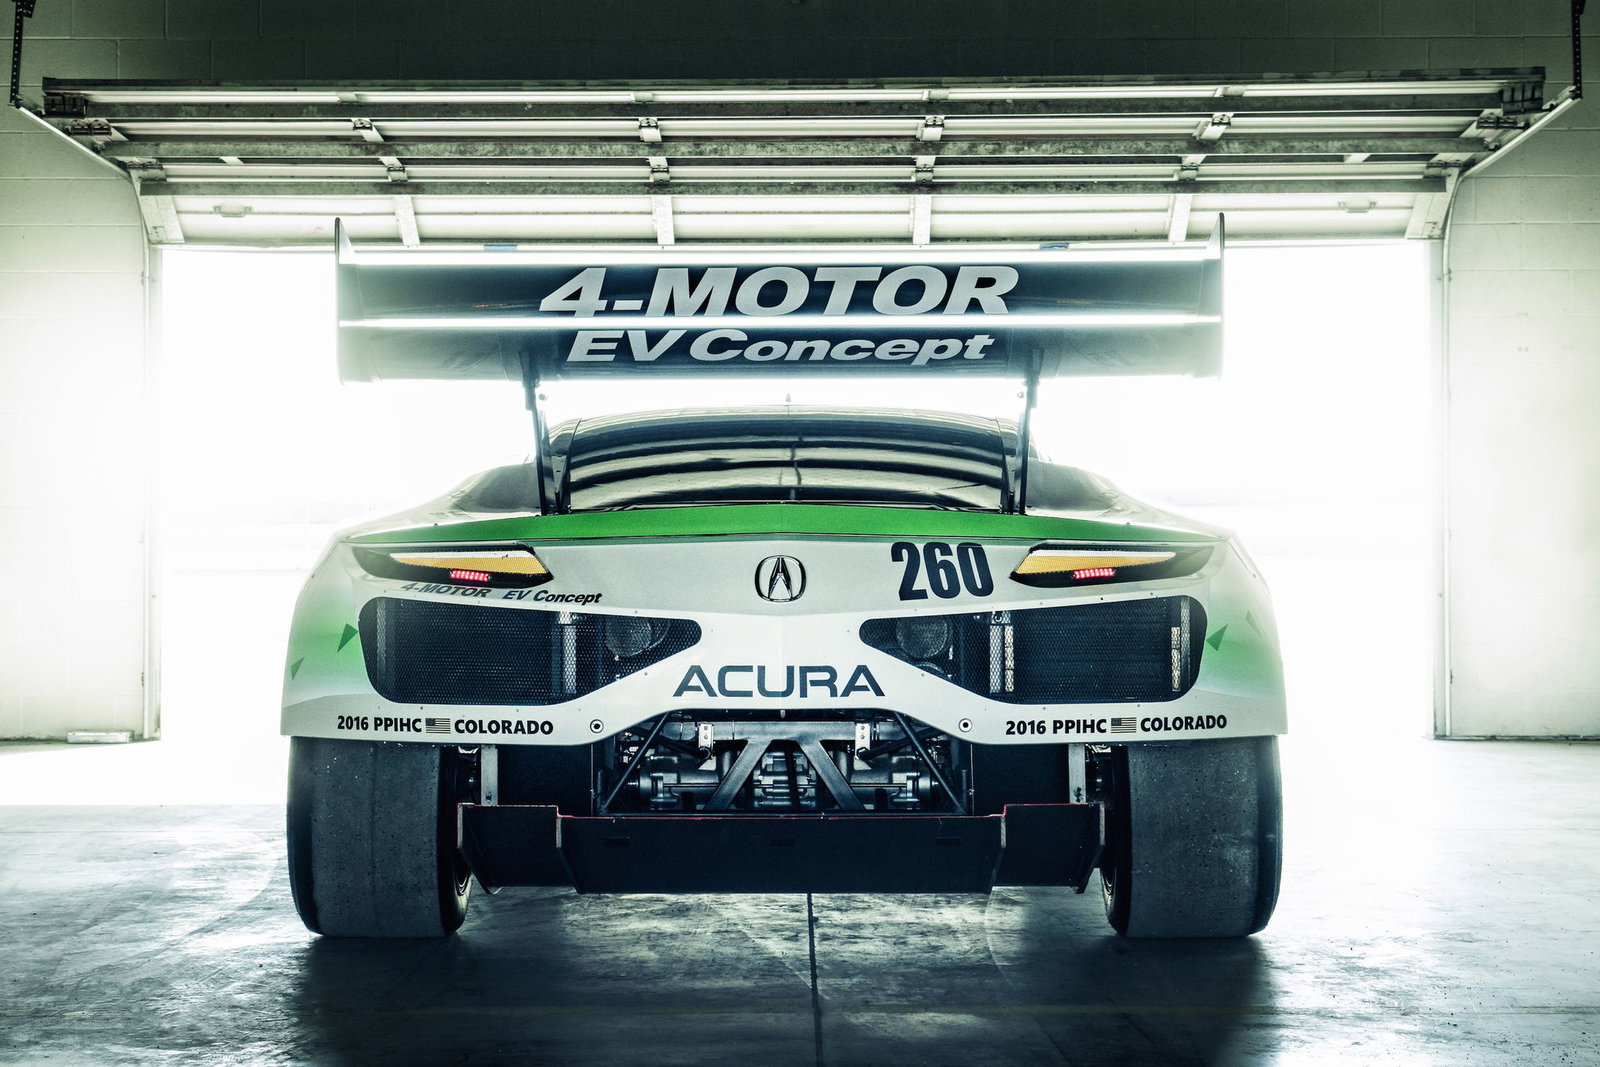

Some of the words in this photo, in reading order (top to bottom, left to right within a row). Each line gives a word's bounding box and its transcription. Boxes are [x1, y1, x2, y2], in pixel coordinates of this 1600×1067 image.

[538, 265, 1019, 317] 4-MOTOR
[566, 329, 687, 362] EV
[689, 329, 995, 366] Concept
[891, 541, 994, 601] 260
[400, 582, 492, 598] 4-MOTOR
[501, 590, 532, 601] EV
[533, 589, 603, 606] Concept
[672, 664, 886, 698] ACURA
[337, 715, 369, 731] 2016
[373, 716, 422, 733] PPIHC
[454, 719, 554, 735] COLORADO
[1005, 719, 1046, 736] 2016
[1052, 718, 1107, 734] PPIHC
[1140, 714, 1228, 732] COLORADO
